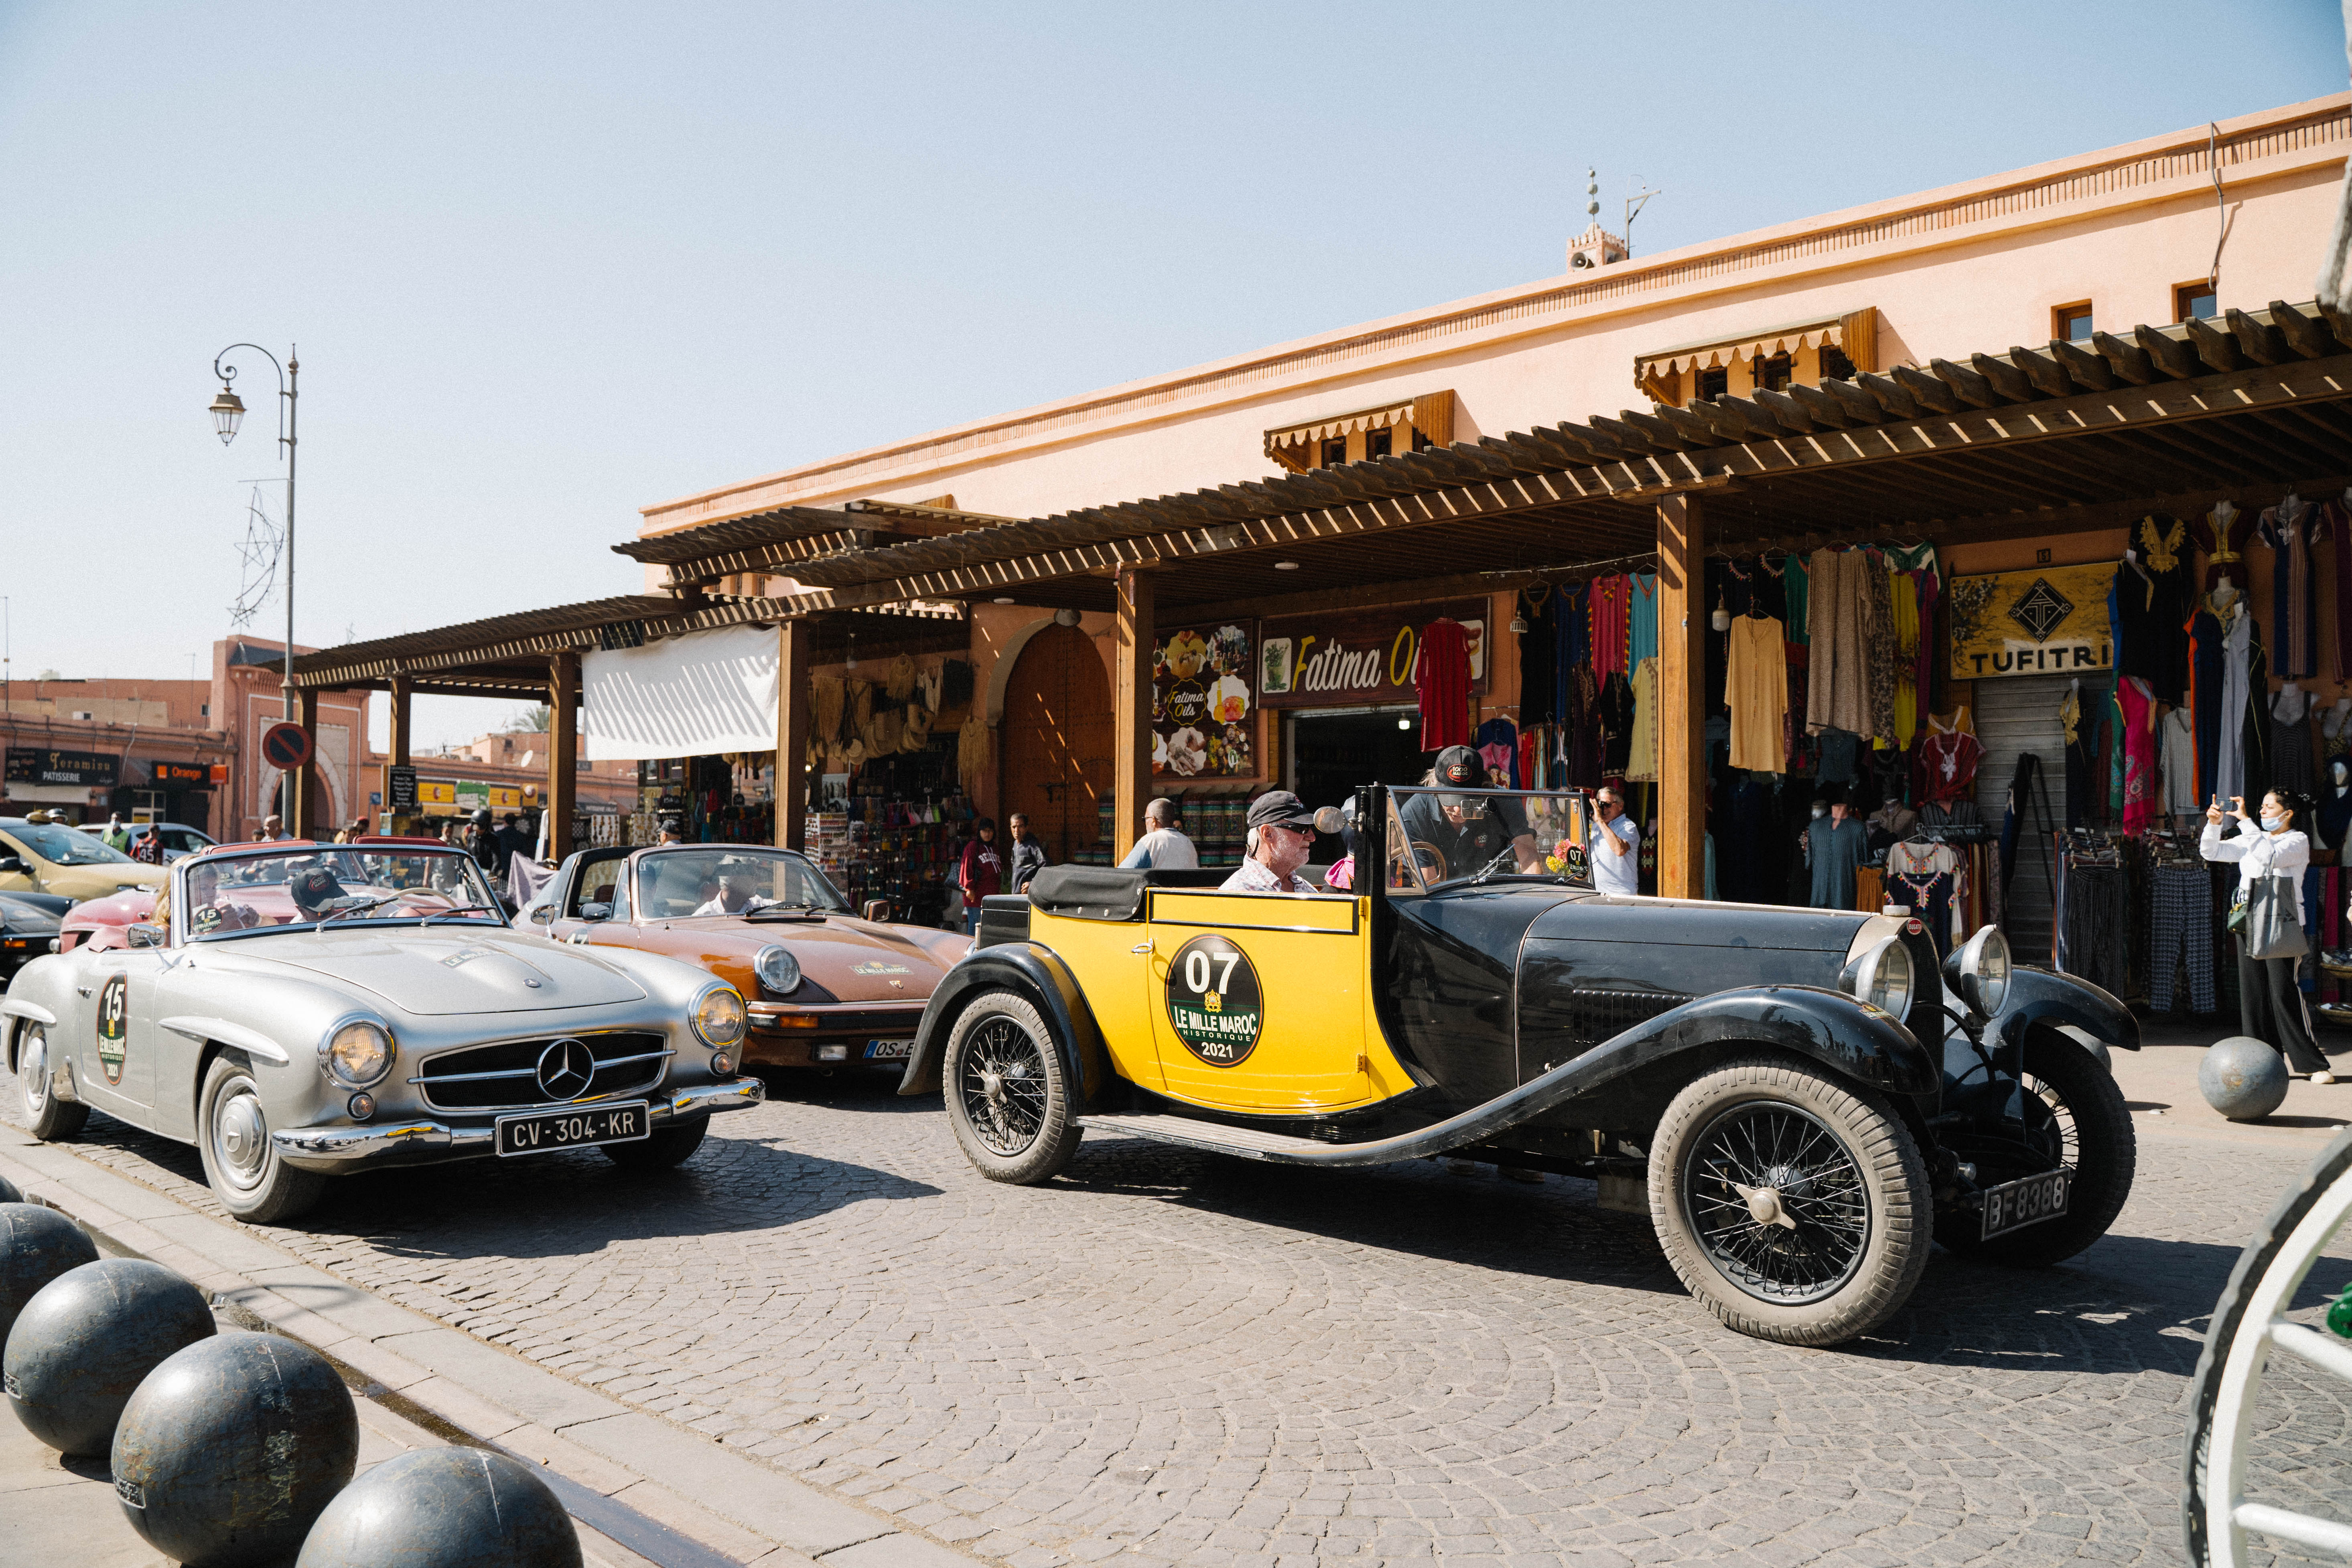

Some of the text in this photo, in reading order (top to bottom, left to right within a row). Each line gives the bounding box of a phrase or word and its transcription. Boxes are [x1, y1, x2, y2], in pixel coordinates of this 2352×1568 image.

[1291, 625, 1422, 692] Fatima Oi
[1970, 645, 2108, 673] TUFITRI
[1169, 691, 1205, 704] Fatima
[1175, 704, 1195, 717] Oils
[924, 742, 943, 753] RICE
[43, 771, 80, 782] PATISSERIE
[172, 766, 201, 781] Orange
[140, 848, 154, 862] 45
[1570, 850, 1581, 861] 07
[198, 909, 216, 921] 15
[445, 957, 462, 966] LE
[1185, 950, 1239, 994] 07
[105, 983, 125, 1021] 15
[1174, 1006, 1256, 1035] LE MILLE MAROC
[1183, 1029, 1251, 1042] HISTORIQUE
[876, 1043, 898, 1056] OS
[1201, 1042, 1233, 1058] 2021
[101, 1053, 123, 1061] HISTORIQUE
[107, 1063, 118, 1077] 2021
